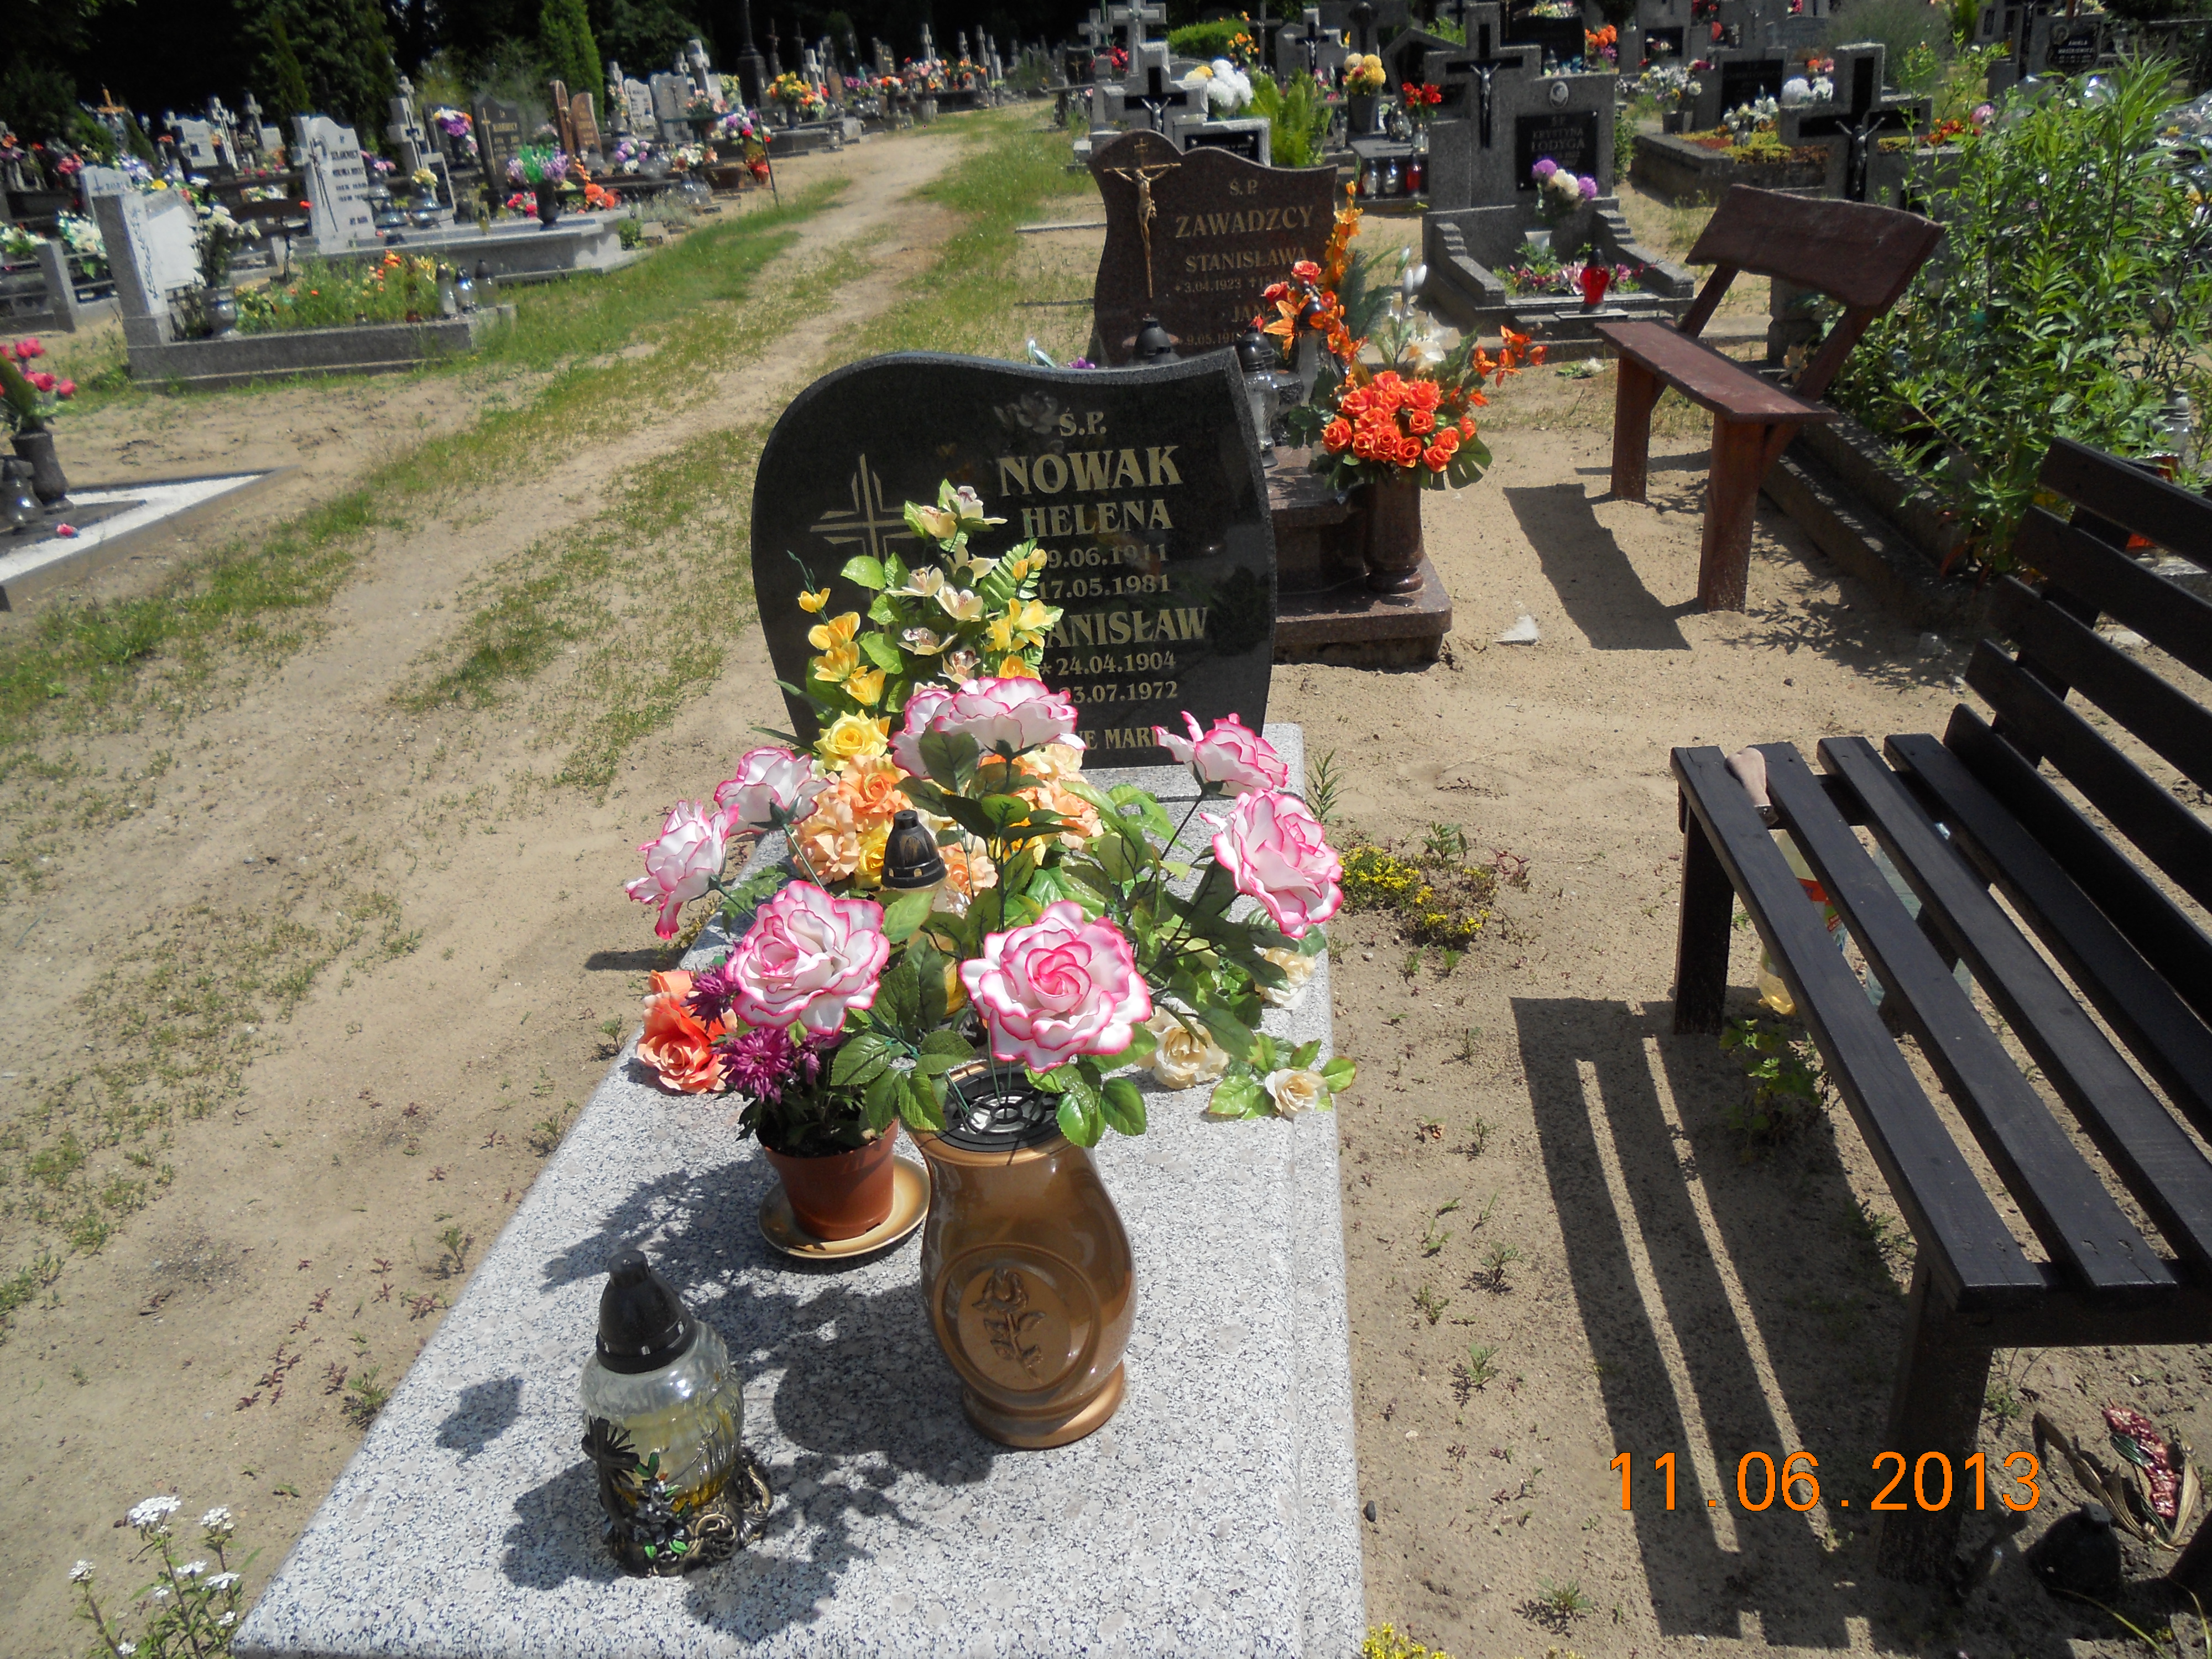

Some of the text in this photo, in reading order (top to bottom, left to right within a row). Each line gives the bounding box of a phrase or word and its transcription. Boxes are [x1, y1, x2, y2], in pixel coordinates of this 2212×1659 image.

[1175, 205, 1313, 238] ZAWADZCY
[997, 445, 1183, 497] NOWAK
[1021, 499, 1174, 539] HELENA
[1046, 544, 1169, 568] 9.06.1911
[1037, 574, 1171, 600] 17.05.1981
[1046, 607, 1208, 649] ANISŁAW
[1056, 650, 1177, 676] 24.04.1904
[1104, 726, 1169, 749] MARI
